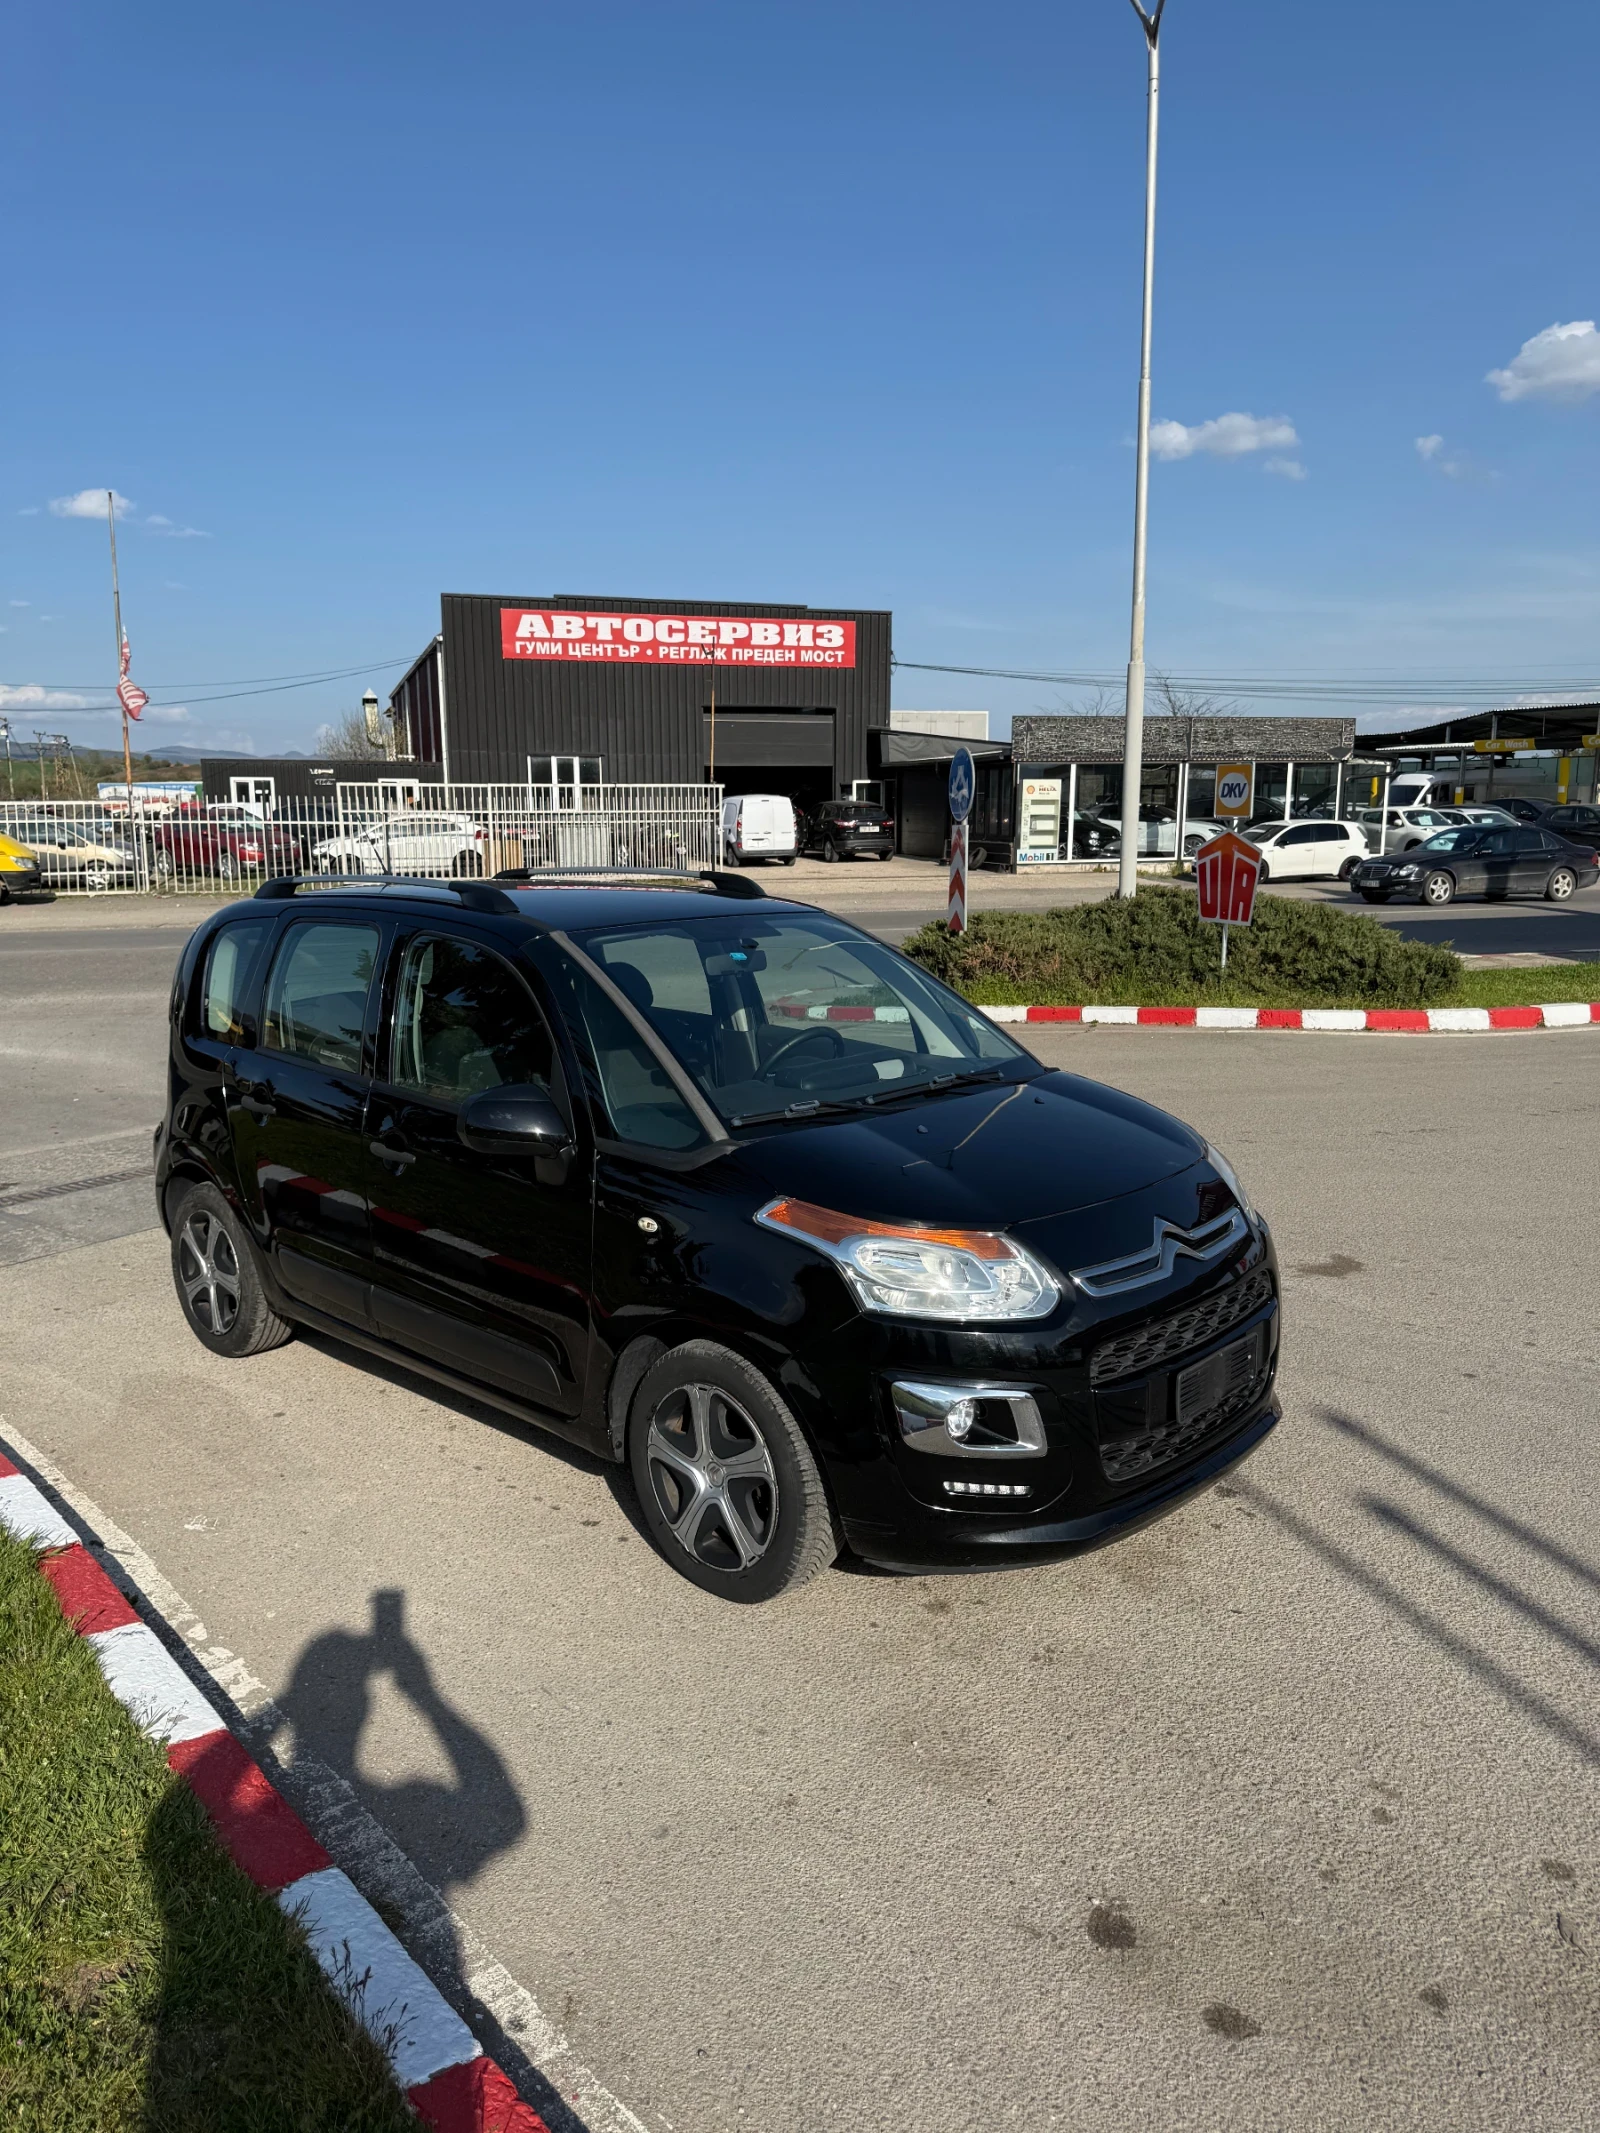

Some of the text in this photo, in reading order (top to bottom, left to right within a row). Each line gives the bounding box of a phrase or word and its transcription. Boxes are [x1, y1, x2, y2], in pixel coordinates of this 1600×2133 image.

[515, 614, 845, 647] АВТОСЕРВИЗ
[515, 641, 563, 655] ГУМИ
[568, 643, 640, 658] ЦЕНТЪР
[732, 648, 796, 663] ПРЕДЕН
[800, 650, 845, 662] МОСТ
[1485, 739, 1529, 749] Car Wash
[1220, 783, 1247, 798] DKV
[1019, 853, 1044, 861] Mobil
